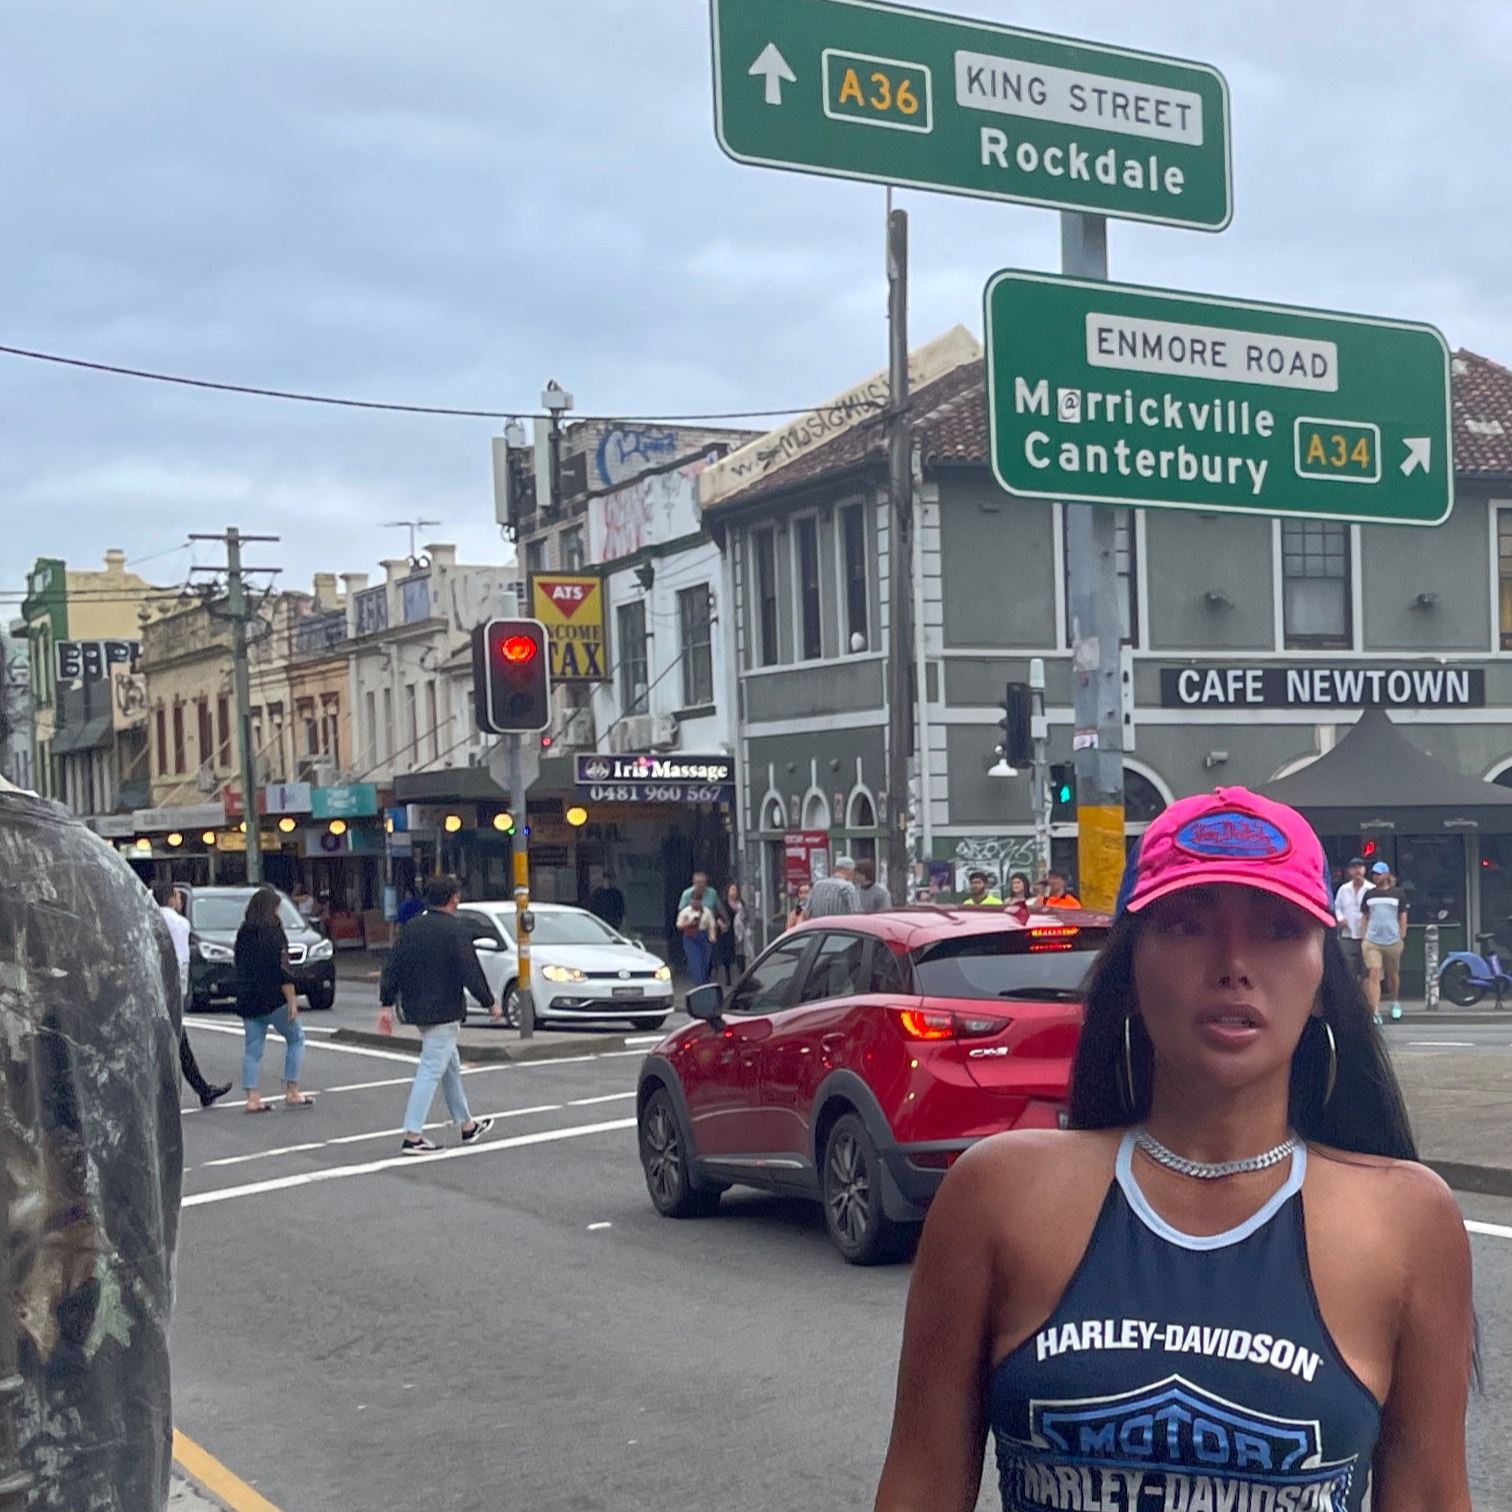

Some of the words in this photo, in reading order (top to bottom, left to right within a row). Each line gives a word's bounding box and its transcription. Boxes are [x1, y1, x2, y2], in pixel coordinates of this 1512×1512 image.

[838, 68, 919, 115] A36
[966, 66, 1047, 106] KING
[1068, 84, 1192, 131] STREET
[980, 126, 1185, 196] Rockdale
[1096, 327, 1228, 369] ENMORE
[1246, 344, 1329, 380] ROAD
[1024, 431, 1270, 496] Canterbury
[1306, 432, 1371, 470] A34
[552, 586, 583, 600] ATS
[545, 624, 601, 640] NCOME
[1177, 669, 1264, 704] CAFE
[1286, 669, 1469, 704] NEWTOWN
[589, 786, 640, 801] 0481
[643, 786, 682, 801] 960
[686, 786, 722, 801] 567
[614, 759, 649, 778] Iris
[651, 760, 728, 783] Massage
[1036, 1319, 1320, 1382] HARLEY-DAVIDSON
[1079, 1403, 1274, 1470] MOTOR
